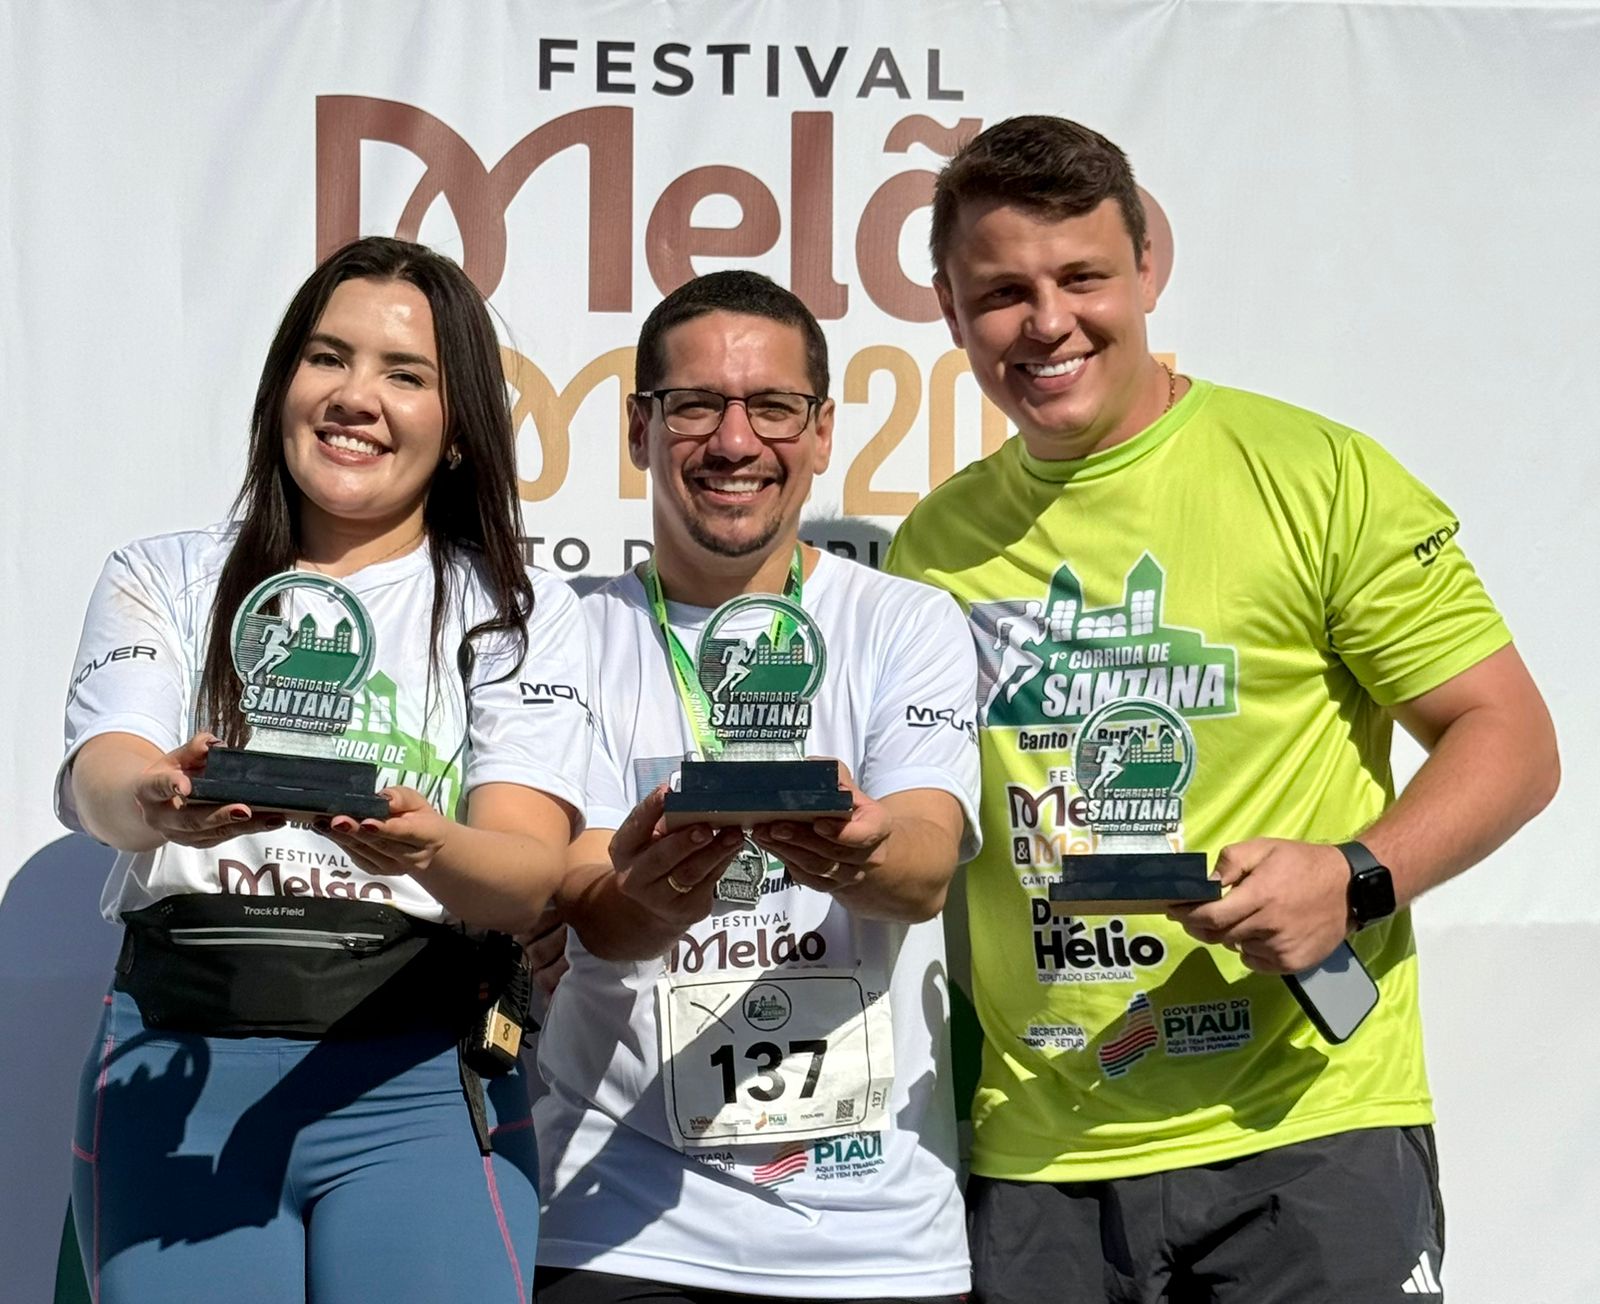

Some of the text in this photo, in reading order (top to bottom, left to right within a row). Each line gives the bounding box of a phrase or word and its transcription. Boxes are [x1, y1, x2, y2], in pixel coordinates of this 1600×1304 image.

[538, 38, 964, 100] FESTIVAL
[316, 95, 1175, 324] Melã
[1068, 644, 1144, 669] CORRIDA
[1147, 643, 1171, 663] DE
[276, 675, 322, 692] CORRIDA
[1042, 664, 1226, 717] SANTANA
[243, 685, 351, 720] SANTANA
[740, 691, 782, 702] CORRIDA
[247, 713, 278, 726] Canto
[711, 703, 809, 726] SANTANA
[717, 729, 745, 738] Canto
[1018, 731, 1068, 750] Canto
[333, 738, 407, 764] RIDA DE
[1087, 799, 1179, 820] SANTANA
[265, 847, 349, 868] FESTIVAL
[243, 905, 271, 916] Track
[280, 906, 305, 917] Field
[712, 911, 789, 930] FESTIVAL
[670, 923, 827, 974] Melão
[1033, 920, 1165, 970] Hélio
[1038, 971, 1135, 982] DEPUTADO ESTADUAL
[1162, 999, 1249, 1016] GOVERNO DO
[1030, 1026, 1084, 1037] SECRETARIA
[1054, 1038, 1085, 1048] SETUR
[710, 1039, 829, 1104] 137
[871, 1091, 882, 1108] 137
